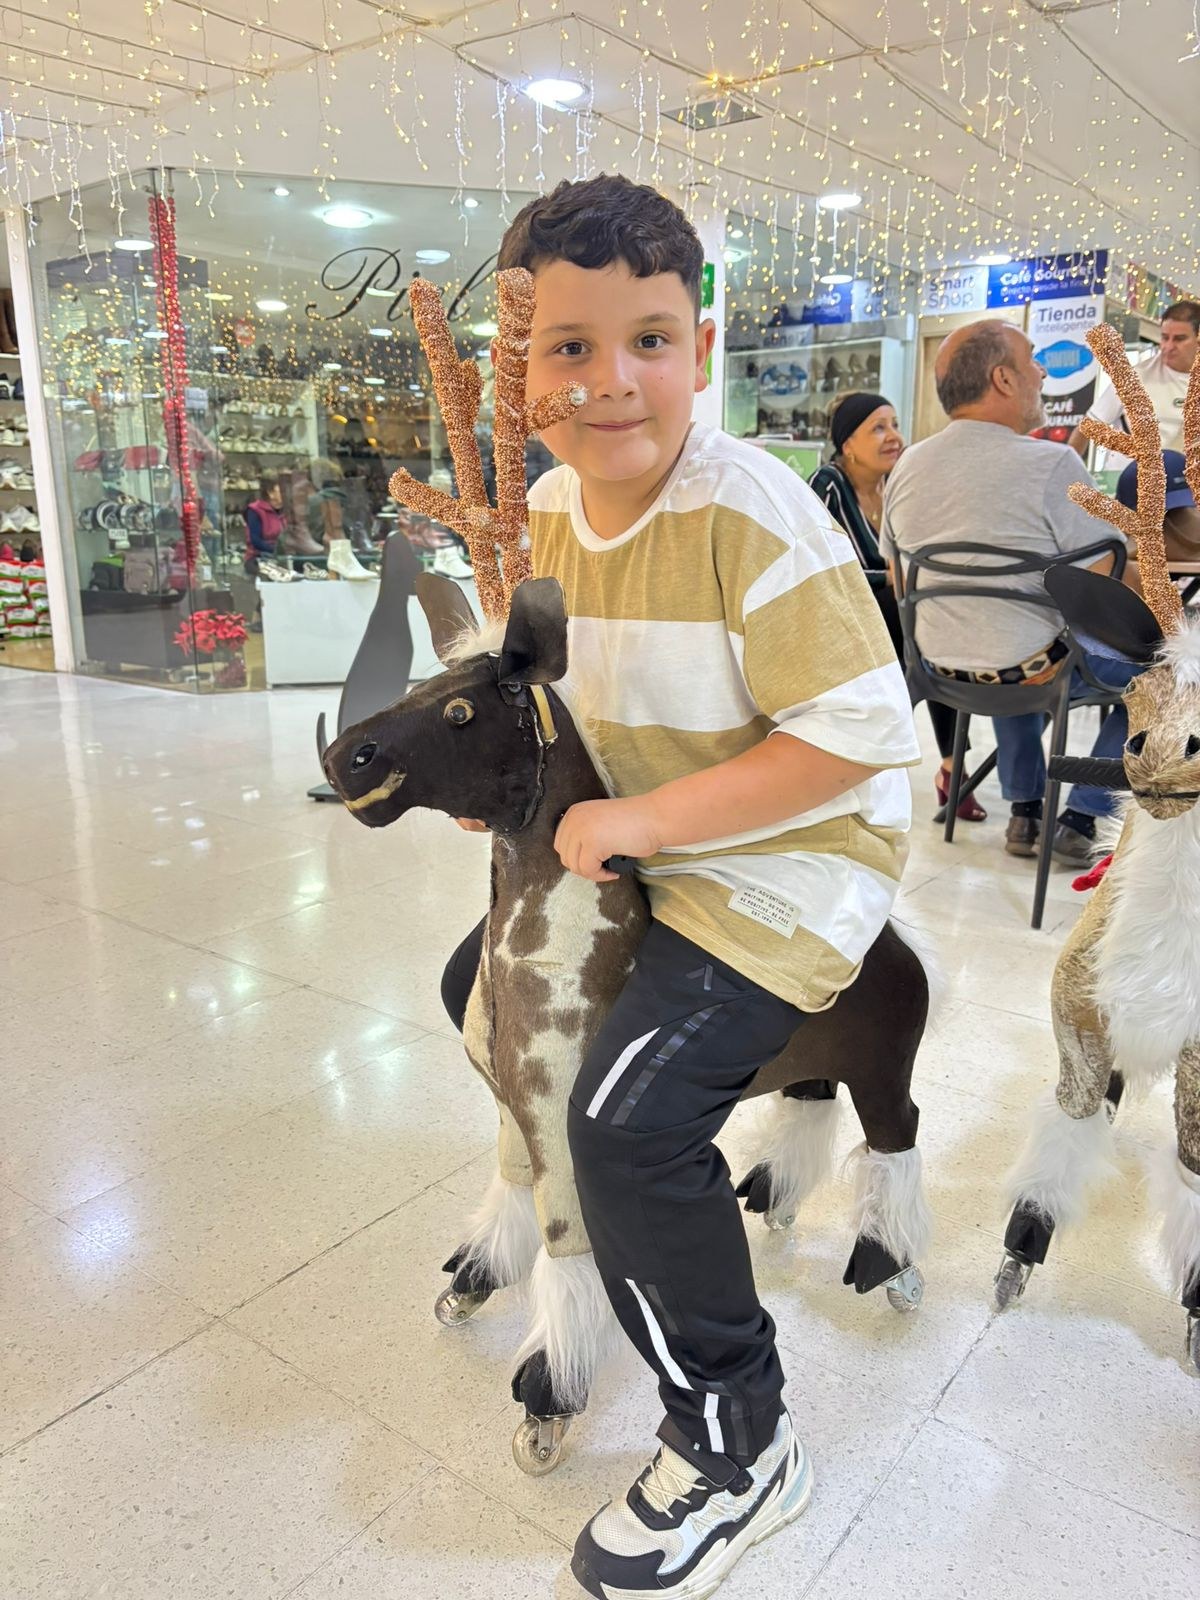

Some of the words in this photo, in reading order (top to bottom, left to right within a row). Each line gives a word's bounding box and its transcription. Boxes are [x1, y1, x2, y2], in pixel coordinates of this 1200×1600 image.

[305, 247, 499, 322] Pil
[930, 276, 974, 291] Smart
[1000, 269, 1032, 286] Café
[929, 292, 974, 309] Shop
[1038, 303, 1096, 322] Tienda
[1043, 398, 1073, 413] CAFÉ
[759, 890, 787, 907] ADVENTURE
